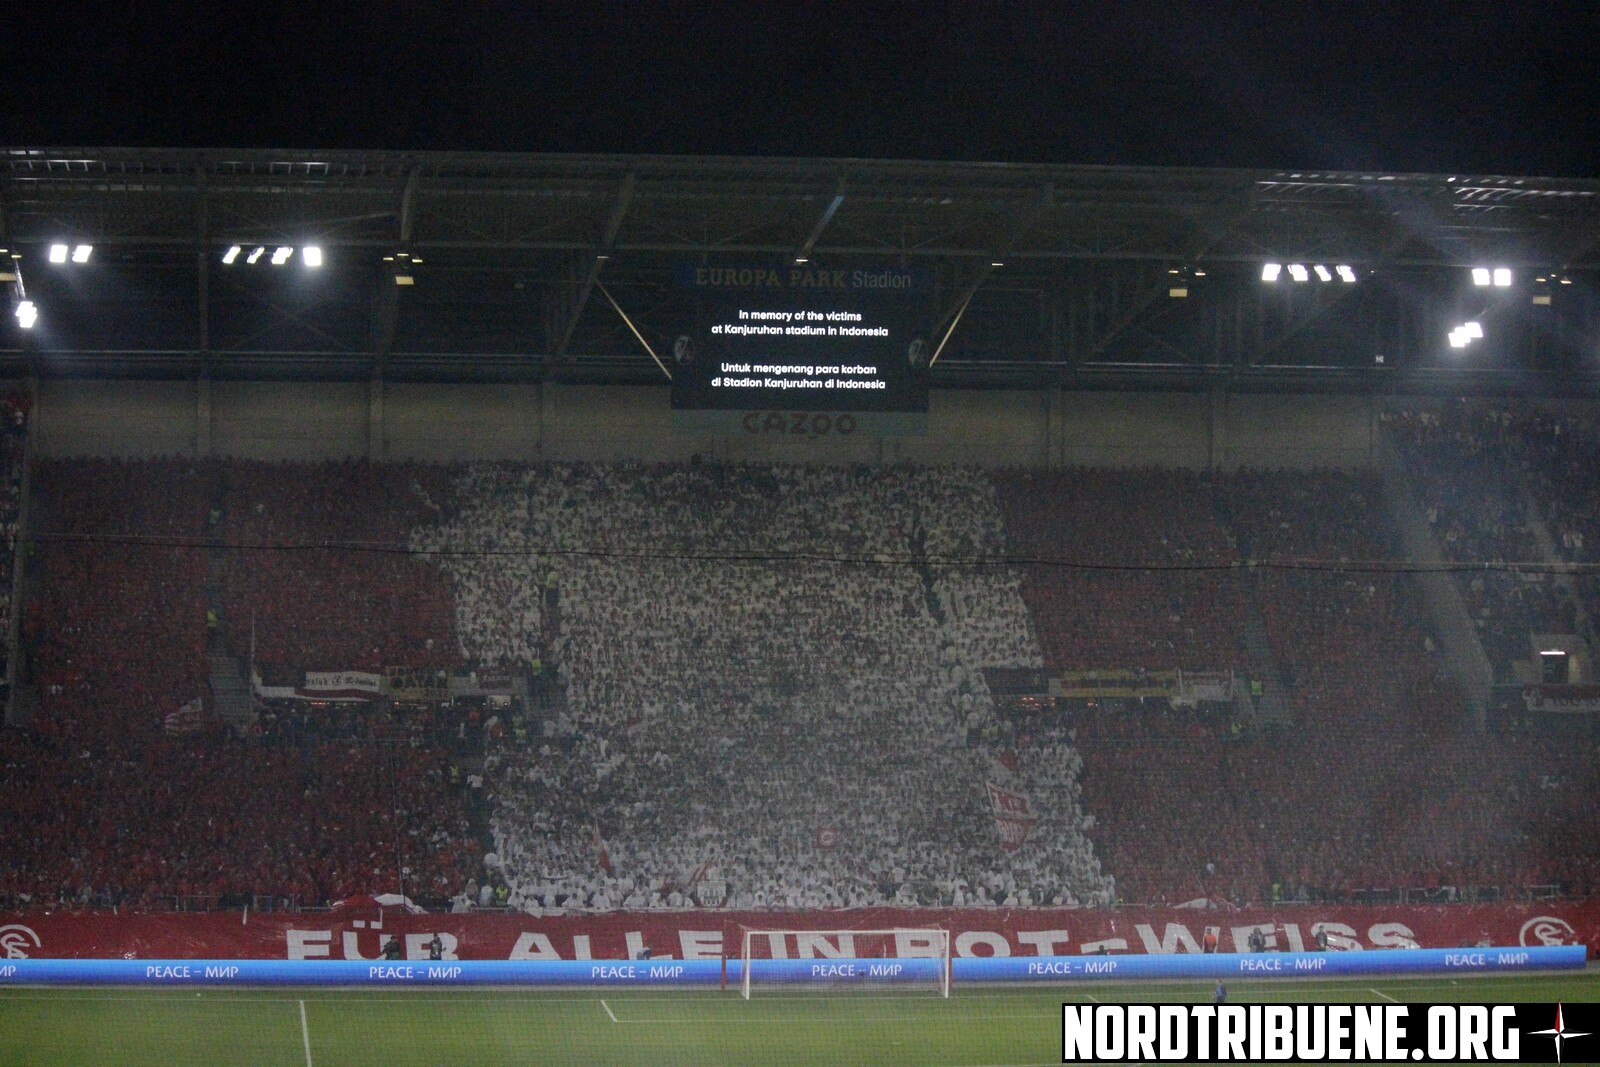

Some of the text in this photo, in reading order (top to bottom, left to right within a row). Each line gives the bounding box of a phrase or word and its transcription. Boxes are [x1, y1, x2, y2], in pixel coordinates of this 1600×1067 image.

[695, 268, 911, 289] EUROPA PARK Stadion
[738, 309, 863, 323] In memory of the victims
[710, 323, 889, 337] at Kanjuruhan stadium in Indonesia
[720, 362, 877, 376] Untuk mengenang para korban
[710, 376, 886, 390] di Stadion Kanjuruhan di Indonesia
[742, 413, 857, 434] CAZOO
[286, 920, 459, 960] FÜR
[508, 930, 723, 960] ALLE
[768, 931, 856, 959] IN
[1240, 959, 1281, 971] PEACE
[1445, 953, 1485, 966] PEACE
[146, 966, 191, 978] PEACE
[369, 966, 413, 979] PEACE
[592, 966, 636, 978] PEACE
[812, 965, 855, 977] PEACE
[1028, 962, 1071, 974] PEACE
